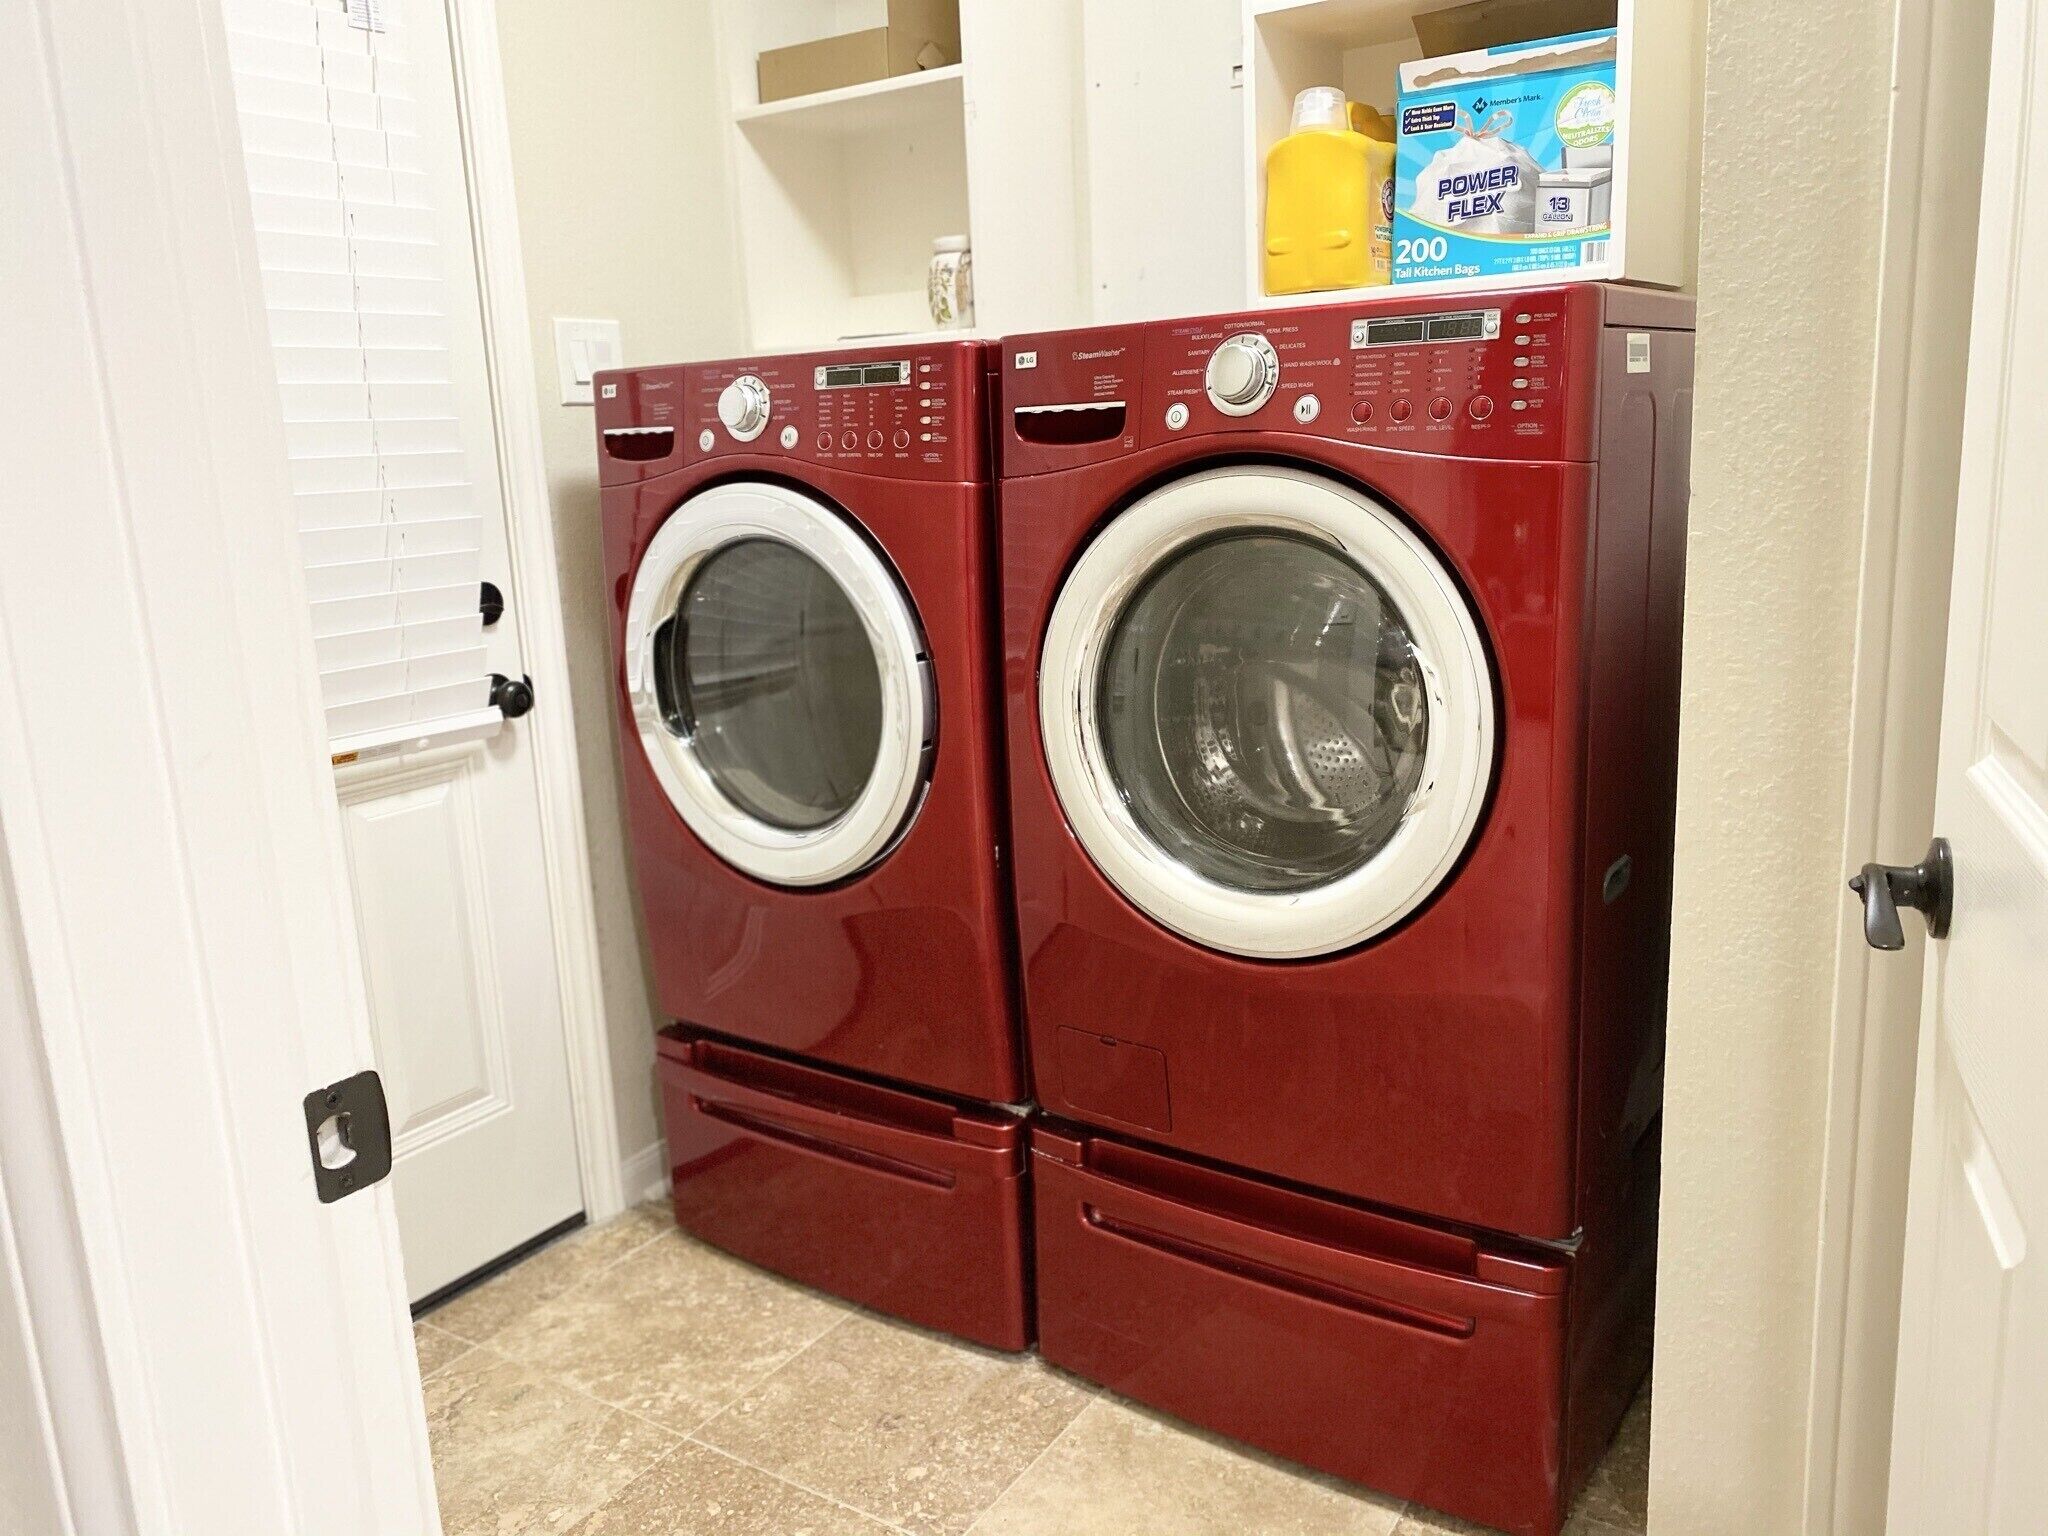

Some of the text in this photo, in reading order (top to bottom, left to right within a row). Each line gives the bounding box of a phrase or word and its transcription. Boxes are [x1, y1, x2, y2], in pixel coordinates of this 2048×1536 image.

[1489, 94, 1541, 107] Member's Mark
[1562, 125, 1611, 141] NEUTRALIZES
[1572, 135, 1599, 147] ODORS
[1438, 165, 1519, 199] POWER
[1447, 193, 1505, 222] FLEX
[1549, 197, 1569, 212] 13
[1542, 213, 1573, 221] GALLON
[1566, 222, 1607, 235] DRAWSTRING
[1395, 236, 1448, 265] 200
[1395, 263, 1480, 279] Tall Kitchen Bags
[1223, 320, 1266, 330] COTTON/NORMAL
[1279, 342, 1306, 350] DELICATES
[1187, 349, 1210, 357] SANITARY
[1025, 356, 1034, 365] LG
[1298, 359, 1333, 367] WASH/WOOL
